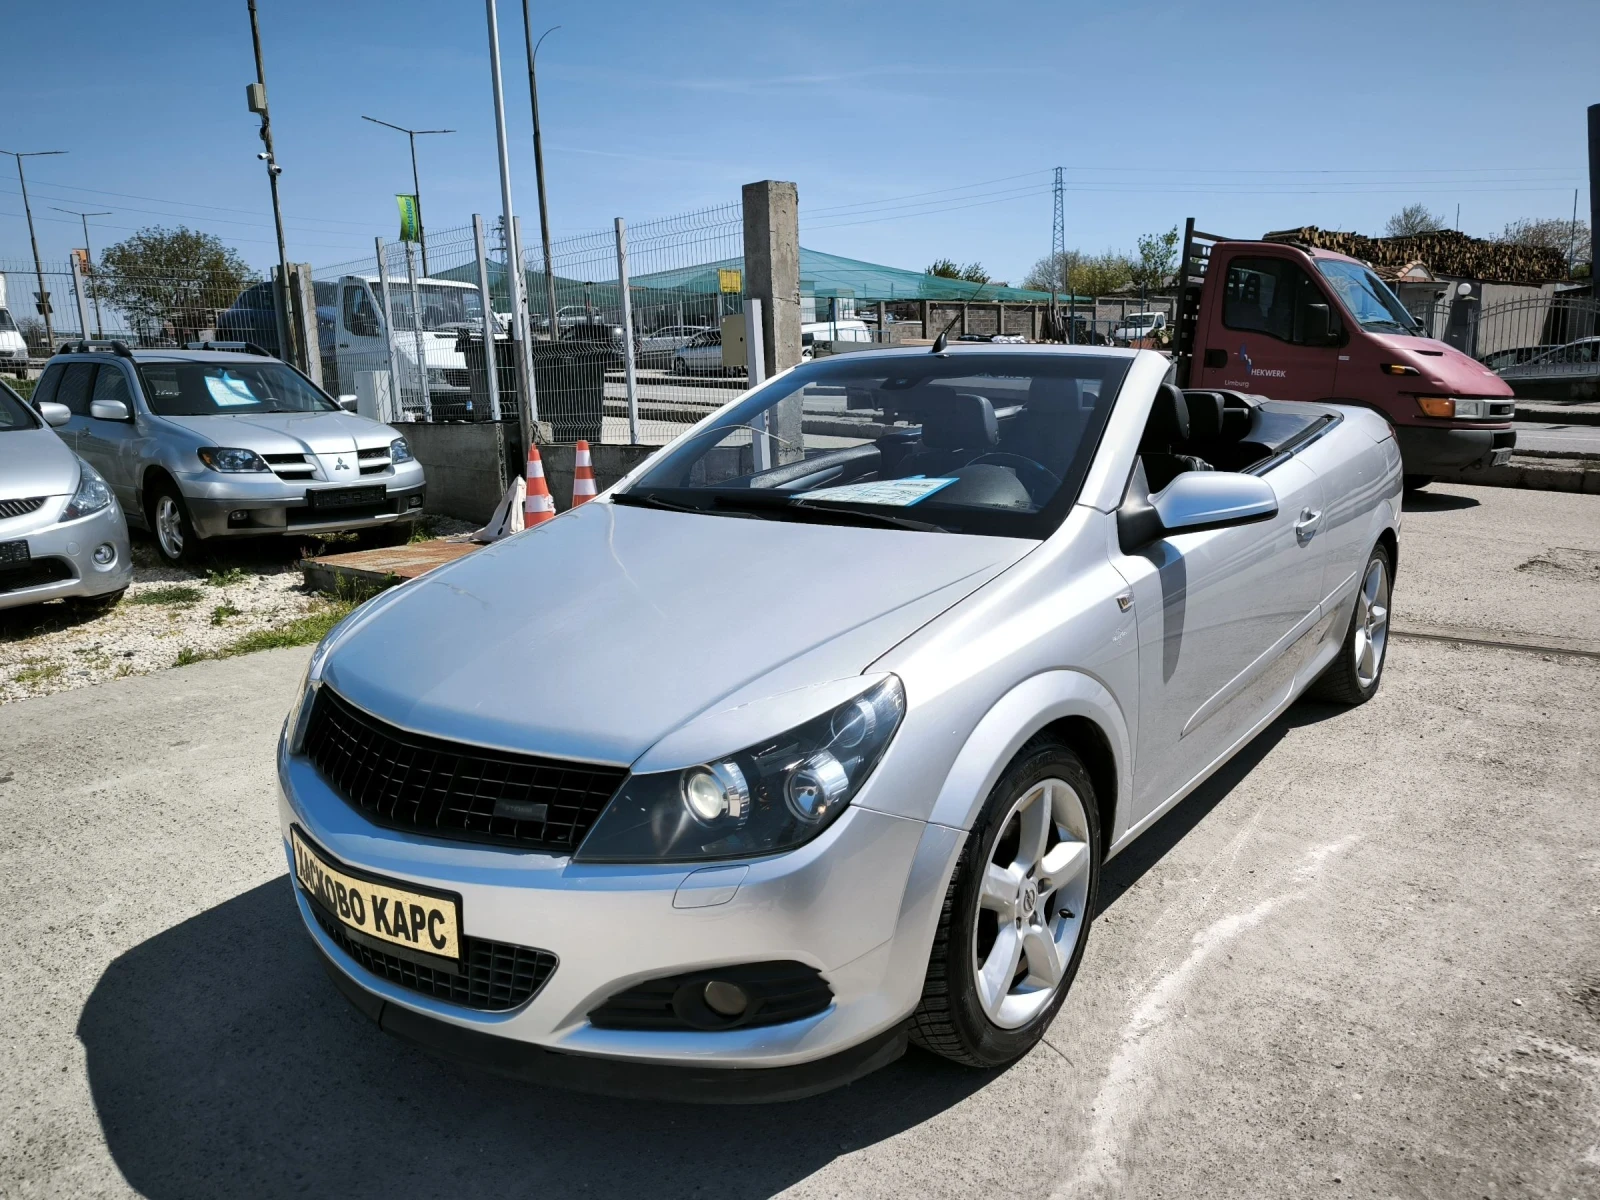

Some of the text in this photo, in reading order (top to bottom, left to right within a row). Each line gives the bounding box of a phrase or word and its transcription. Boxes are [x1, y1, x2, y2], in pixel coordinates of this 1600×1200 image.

[1251, 368, 1287, 378] HEKWERK
[1224, 379, 1250, 388] Limburg
[296, 841, 447, 950] ХАСКОВО КАРС
